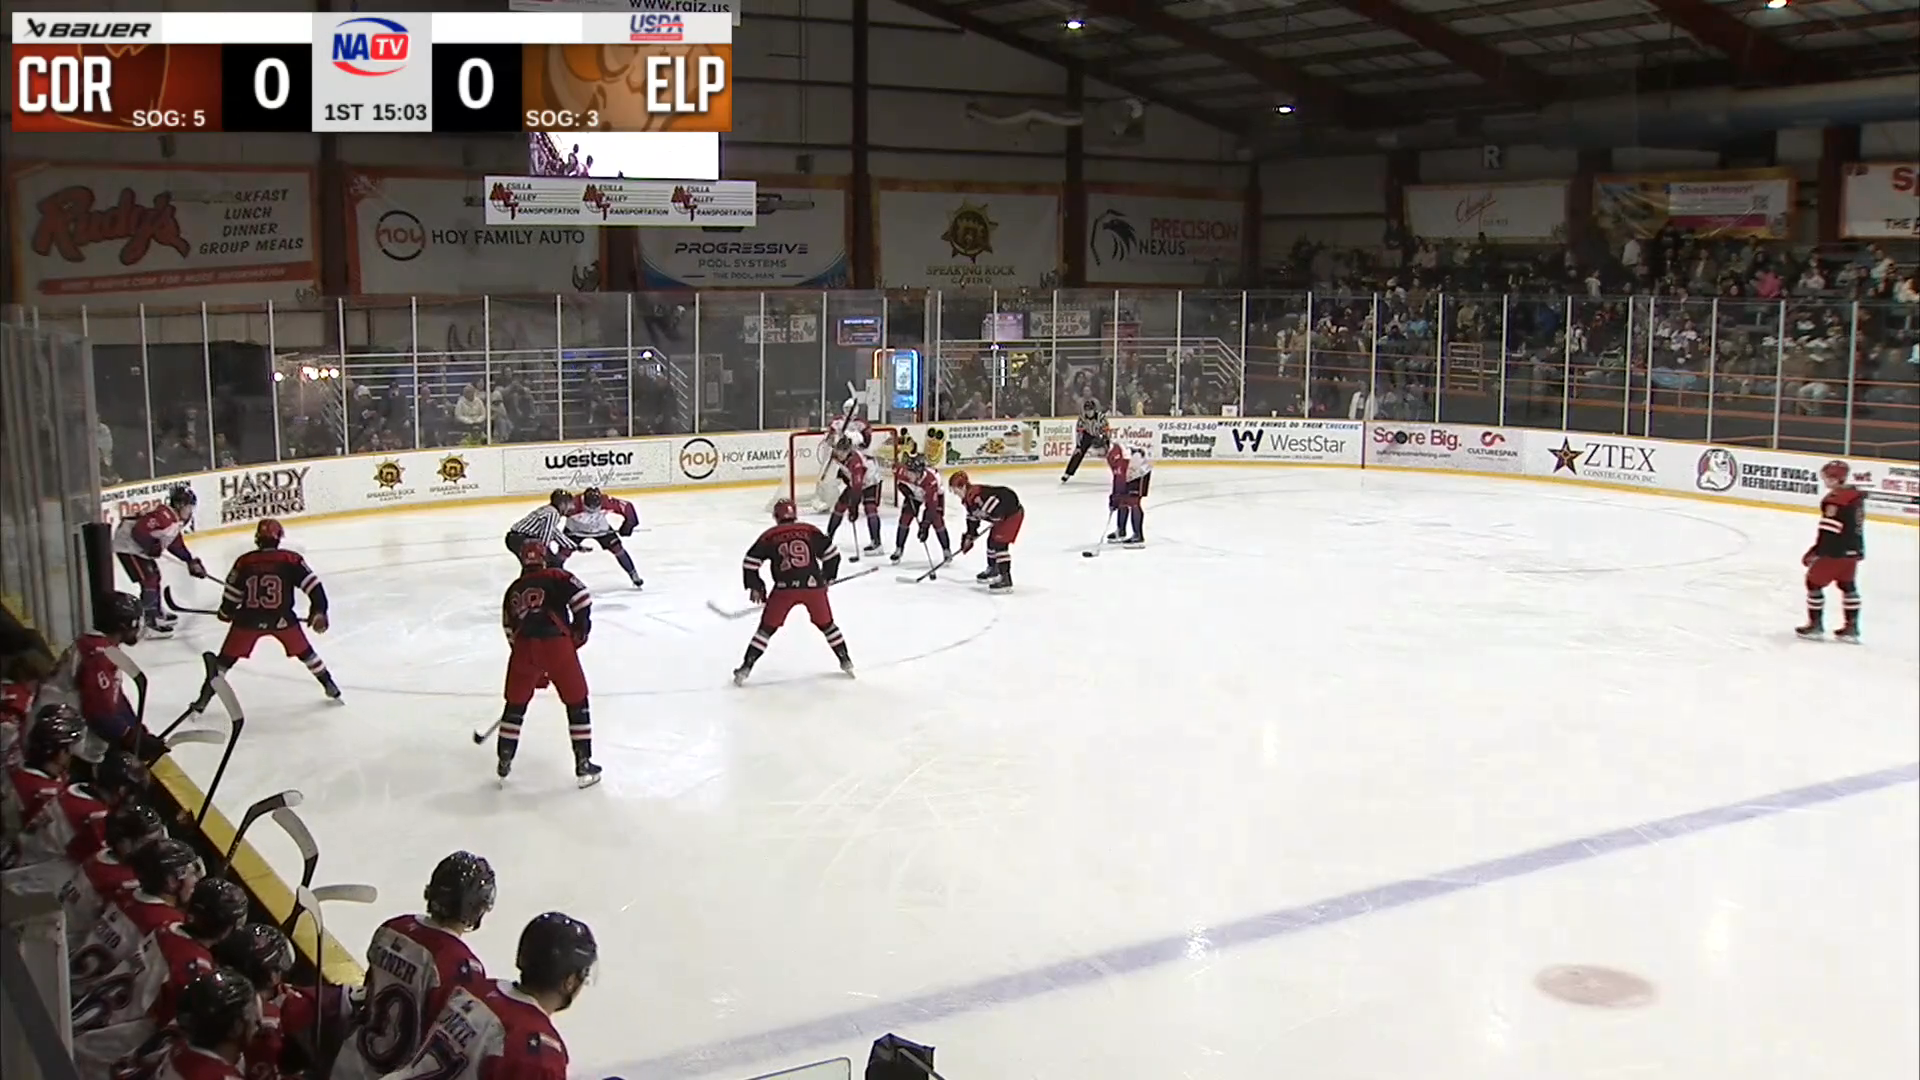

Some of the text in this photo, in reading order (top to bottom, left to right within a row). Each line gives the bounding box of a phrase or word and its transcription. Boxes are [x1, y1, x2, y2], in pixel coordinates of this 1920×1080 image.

[1483, 144, 1500, 169] R
[224, 207, 272, 220] LUNCH
[222, 223, 279, 237] DINNER
[432, 229, 585, 245] HOY FAMILY AUTO
[1150, 218, 1239, 240] PRECISION
[200, 237, 304, 255] GROUP MEALS
[674, 242, 809, 254] PROGRESSIVE
[1139, 239, 1186, 256] NEXUS
[698, 258, 787, 268] POOL SYSTEMS
[925, 265, 1016, 276] SPEAKING ROCK
[980, 424, 1009, 432] PACKED
[1161, 433, 1217, 448] Everything
[1270, 434, 1346, 453] WestStar
[1373, 427, 1462, 451] Score Big.
[722, 451, 744, 463] HOY
[747, 450, 783, 461] FAMILY
[1043, 441, 1073, 457] CAFE
[545, 450, 634, 469] weststar
[1584, 443, 1658, 473] ZTEX
[1583, 470, 1639, 483] CONSTRUCTION
[1742, 464, 1819, 482] EXPERT HVAC &
[220, 466, 311, 498] HARDY
[1742, 477, 1819, 495] REFRIGERATION
[102, 491, 125, 502] ADING
[126, 485, 150, 497] SPINE
[221, 501, 305, 524] DRILLING
[778, 539, 811, 572] 19
[245, 574, 283, 609] 13
